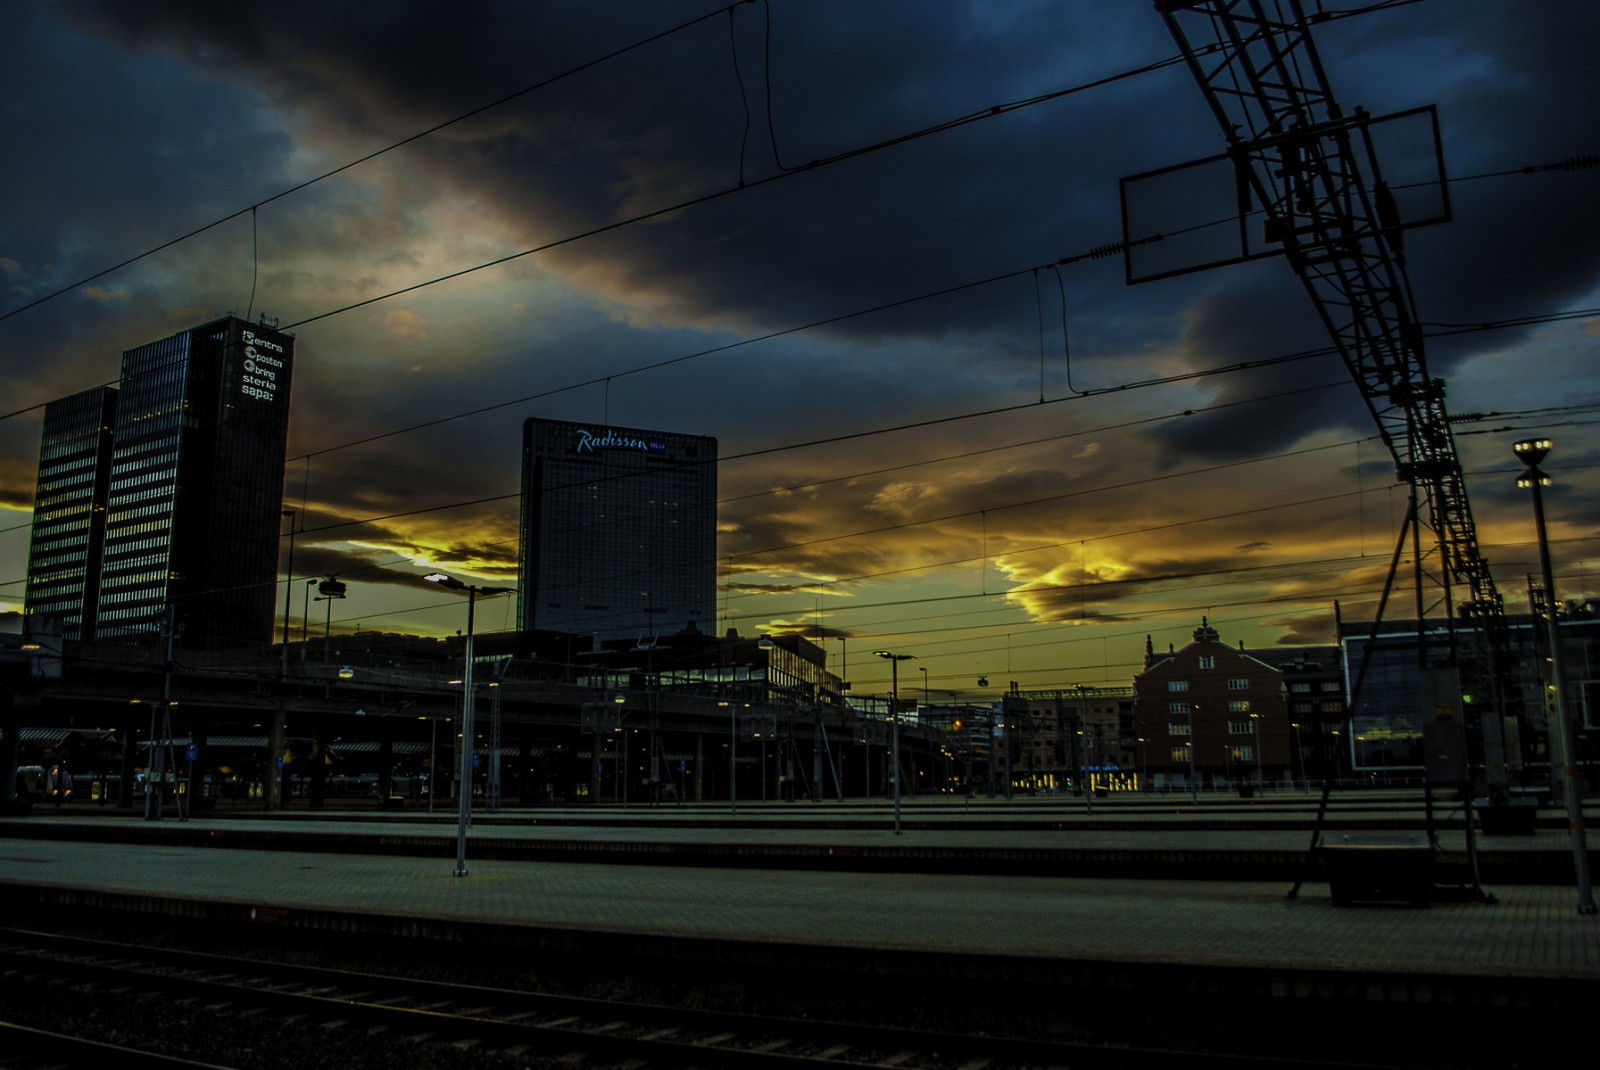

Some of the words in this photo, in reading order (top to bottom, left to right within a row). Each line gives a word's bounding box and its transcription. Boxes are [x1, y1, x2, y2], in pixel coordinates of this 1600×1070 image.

[254, 338, 283, 353] entra
[256, 354, 283, 368] posten
[255, 365, 276, 381] bring
[242, 374, 276, 390] steria
[576, 429, 648, 455] Radisson
